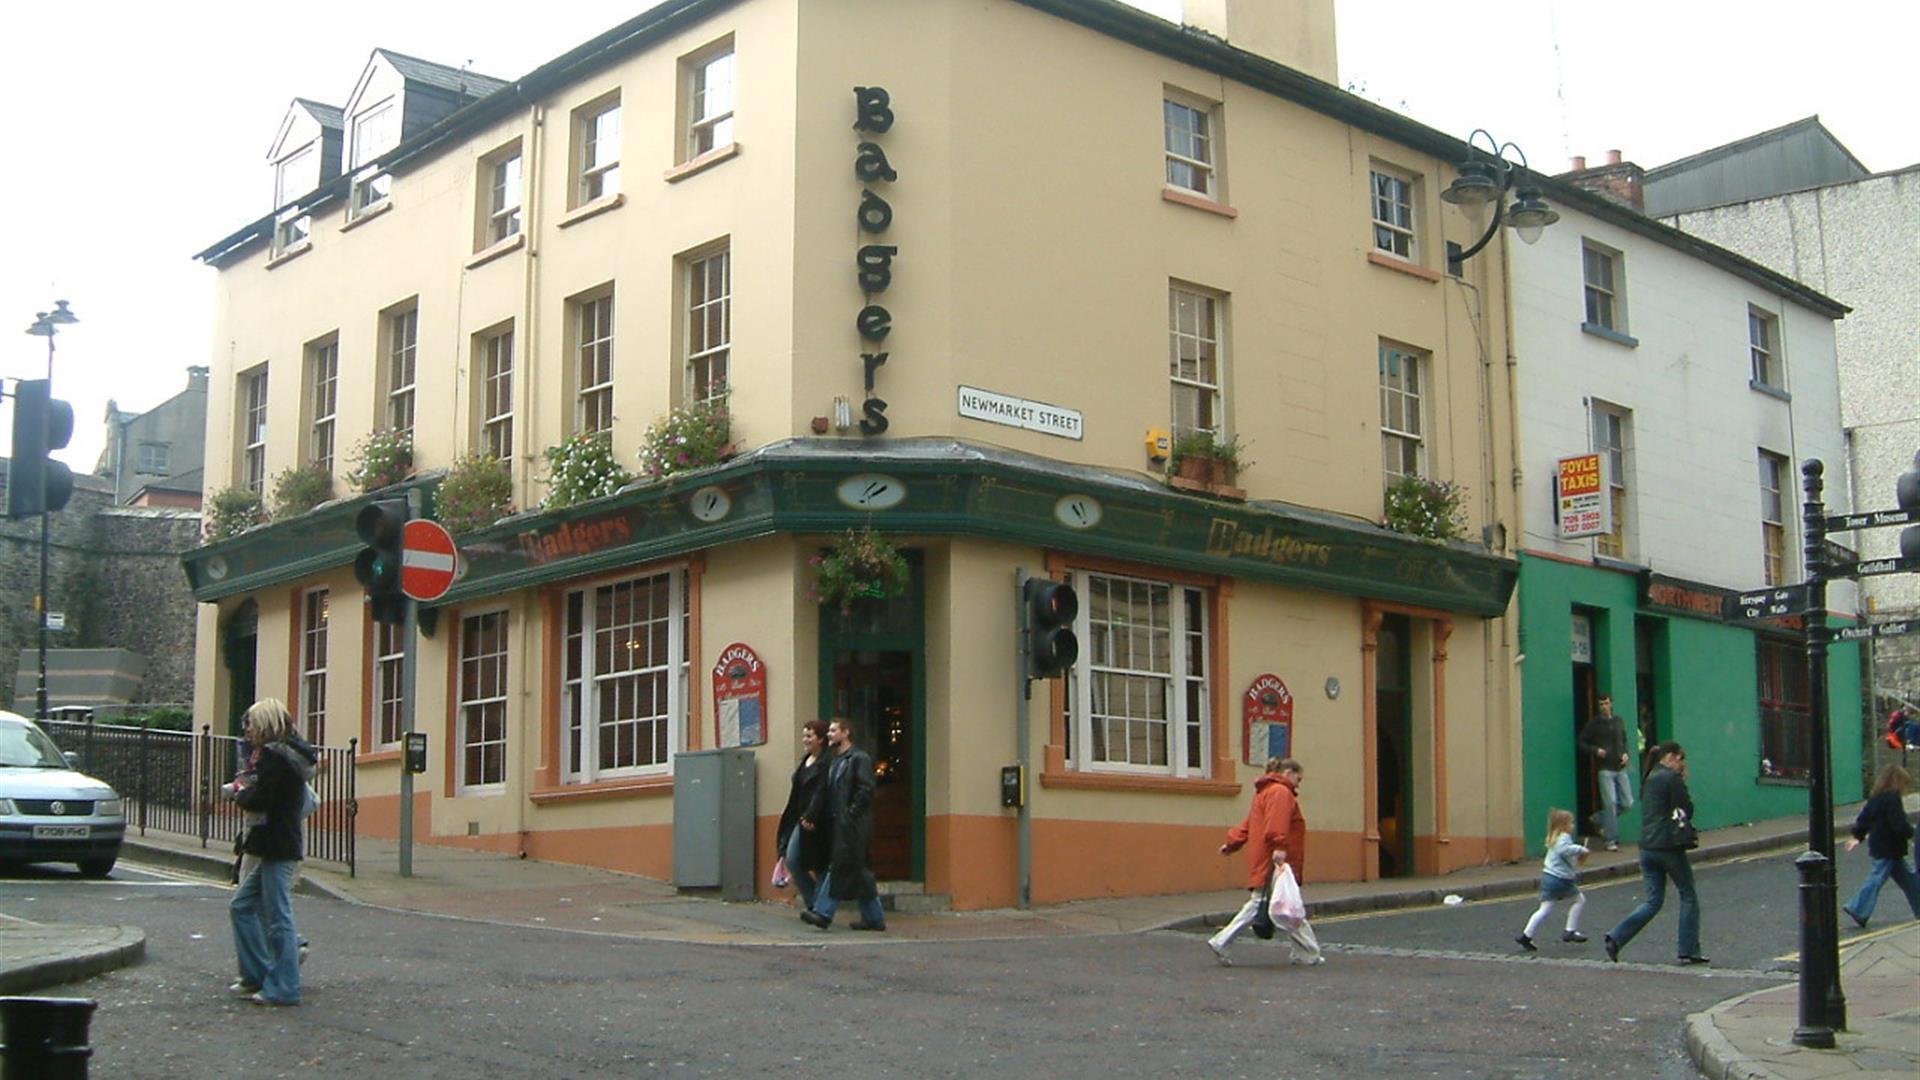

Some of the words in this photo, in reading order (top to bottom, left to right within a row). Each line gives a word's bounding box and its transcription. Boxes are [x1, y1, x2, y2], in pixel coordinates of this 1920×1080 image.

[852, 86, 898, 434] Badgers
[962, 395, 1034, 421] NEWMARKET
[1039, 411, 1079, 430] STREET
[1561, 457, 1598, 475] FOYLE
[1561, 473, 1599, 491] TAXIS
[1874, 512, 1909, 523] Museum
[1857, 560, 1896, 574] Guildhall
